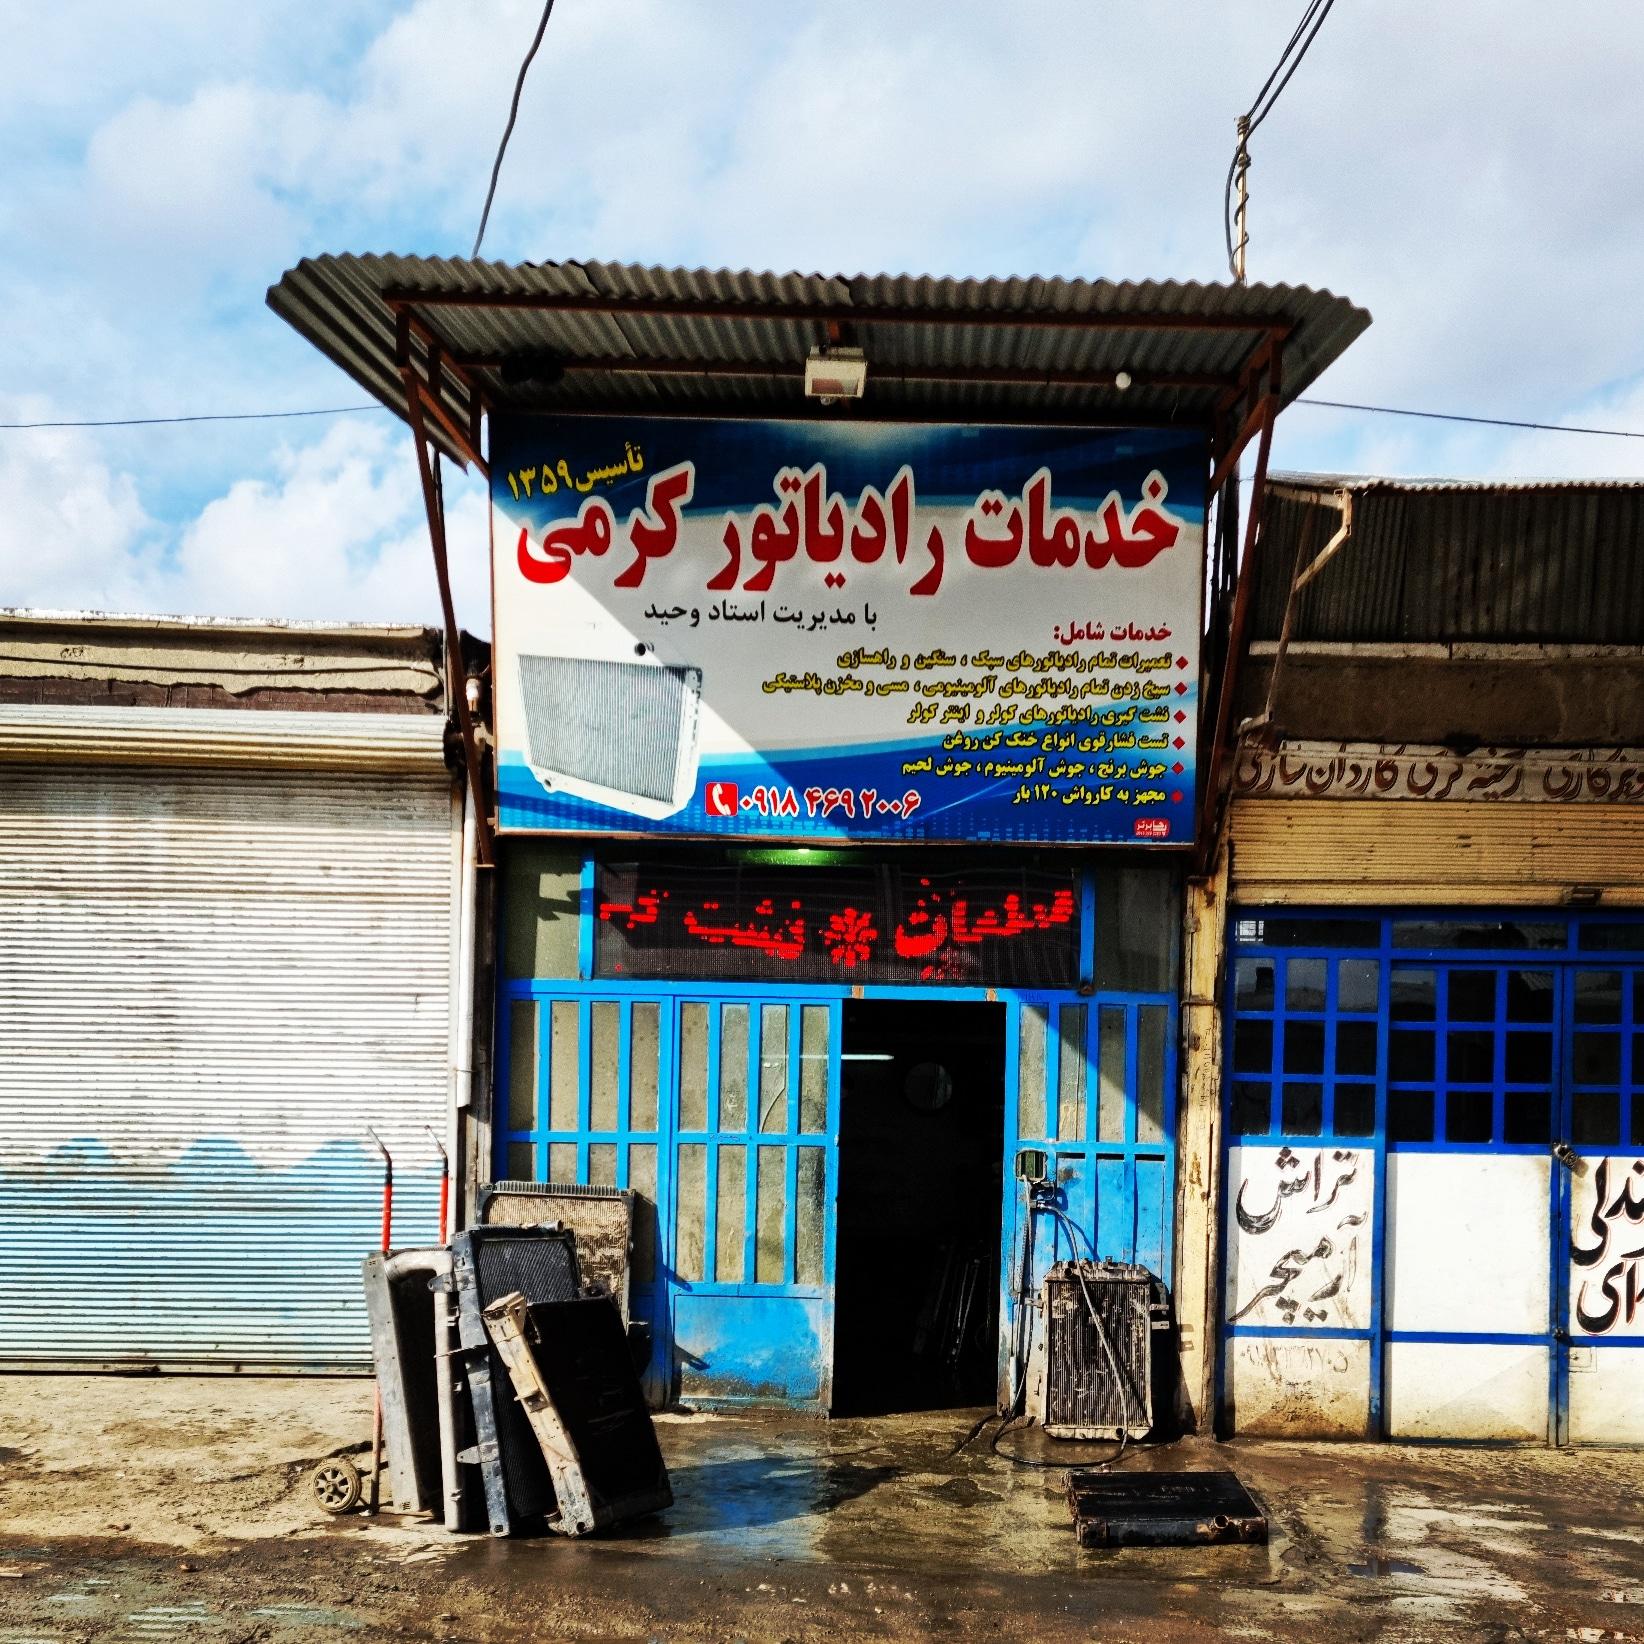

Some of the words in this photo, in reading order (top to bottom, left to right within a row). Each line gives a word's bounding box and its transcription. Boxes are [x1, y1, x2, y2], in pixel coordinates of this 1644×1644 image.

[576, 441, 645, 492] تأسیس
[506, 458, 573, 502] ۱۳۵۹
[516, 467, 691, 589] کرمی
[706, 469, 945, 595] رادیاتور
[963, 475, 1180, 570] خدمات
[644, 601, 701, 628] وحید
[708, 599, 765, 624] استاد
[772, 602, 856, 632] مدیریت
[864, 603, 878, 632] با
[1052, 620, 1105, 646] شامل:
[1109, 621, 1173, 642] خدمات
[836, 646, 897, 670] راهسازی
[901, 655, 910, 670] و
[914, 649, 956, 670] سنگین
[1005, 650, 1085, 673] رادیاتورهای
[1088, 650, 1117, 673] تمام
[1118, 651, 1173, 673] تعمیرات
[762, 672, 823, 695] پلاستیکی
[823, 674, 864, 695] مخزن
[864, 681, 875, 696] و
[876, 681, 909, 696] مسی
[998, 676, 1078, 700] رادیاتورهای
[1080, 677, 1110, 699] تمام
[1110, 679, 1140, 699] زدن
[1142, 679, 1171, 700] سیخ
[907, 701, 939, 724] کولر
[940, 702, 970, 724] اینتر
[974, 709, 984, 725] و
[986, 703, 1019, 725] کولر
[1018, 704, 1099, 726] رادیاتورهای
[1101, 705, 1137, 726] گیری
[1138, 706, 1170, 723] نشت
[942, 731, 980, 751] روغن
[982, 731, 1003, 751] کن
[1004, 730, 1038, 747] خنک
[1041, 732, 1076, 752] انواع
[1137, 732, 1169, 749] تست
[902, 756, 932, 776] لحیم
[936, 757, 972, 776] جوش
[1049, 760, 1085, 778] جوش
[1131, 761, 1168, 780] جوش
[739, 785, 799, 818] ۰۹۱۸
[803, 786, 855, 818] ۴۶۹
[859, 788, 922, 820] ۲۰۰۶
[1012, 784, 1031, 805] بار
[1033, 785, 1058, 801] ۱۲۰
[1062, 786, 1114, 804] کارواش
[1116, 788, 1132, 805] به
[1133, 789, 1166, 805] مجهز
[1236, 1147, 1360, 1235] تراش
